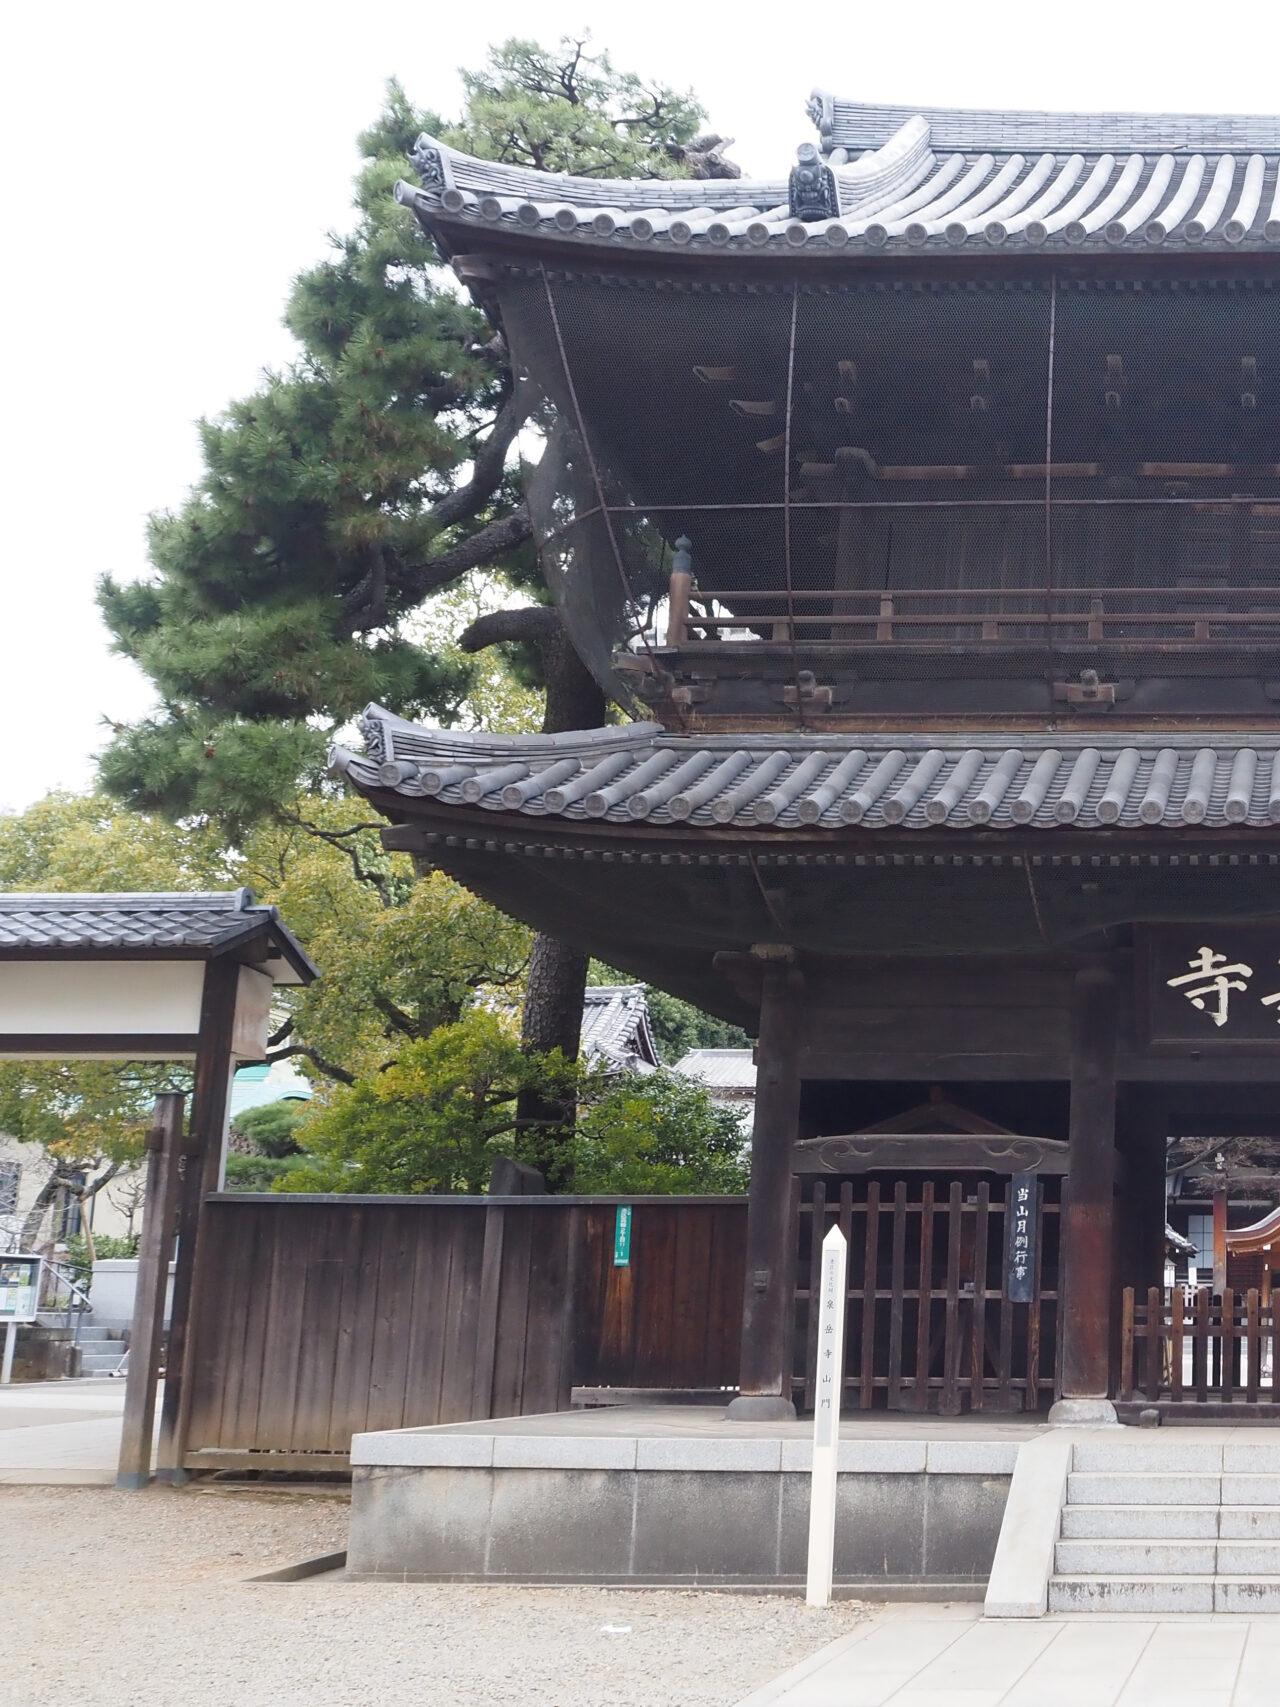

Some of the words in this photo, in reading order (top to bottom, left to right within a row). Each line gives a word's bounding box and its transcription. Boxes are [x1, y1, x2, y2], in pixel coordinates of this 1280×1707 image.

[1014, 1188, 1029, 1280] 当山月例行事
[821, 1299, 834, 1409] 泉岳寺山門
